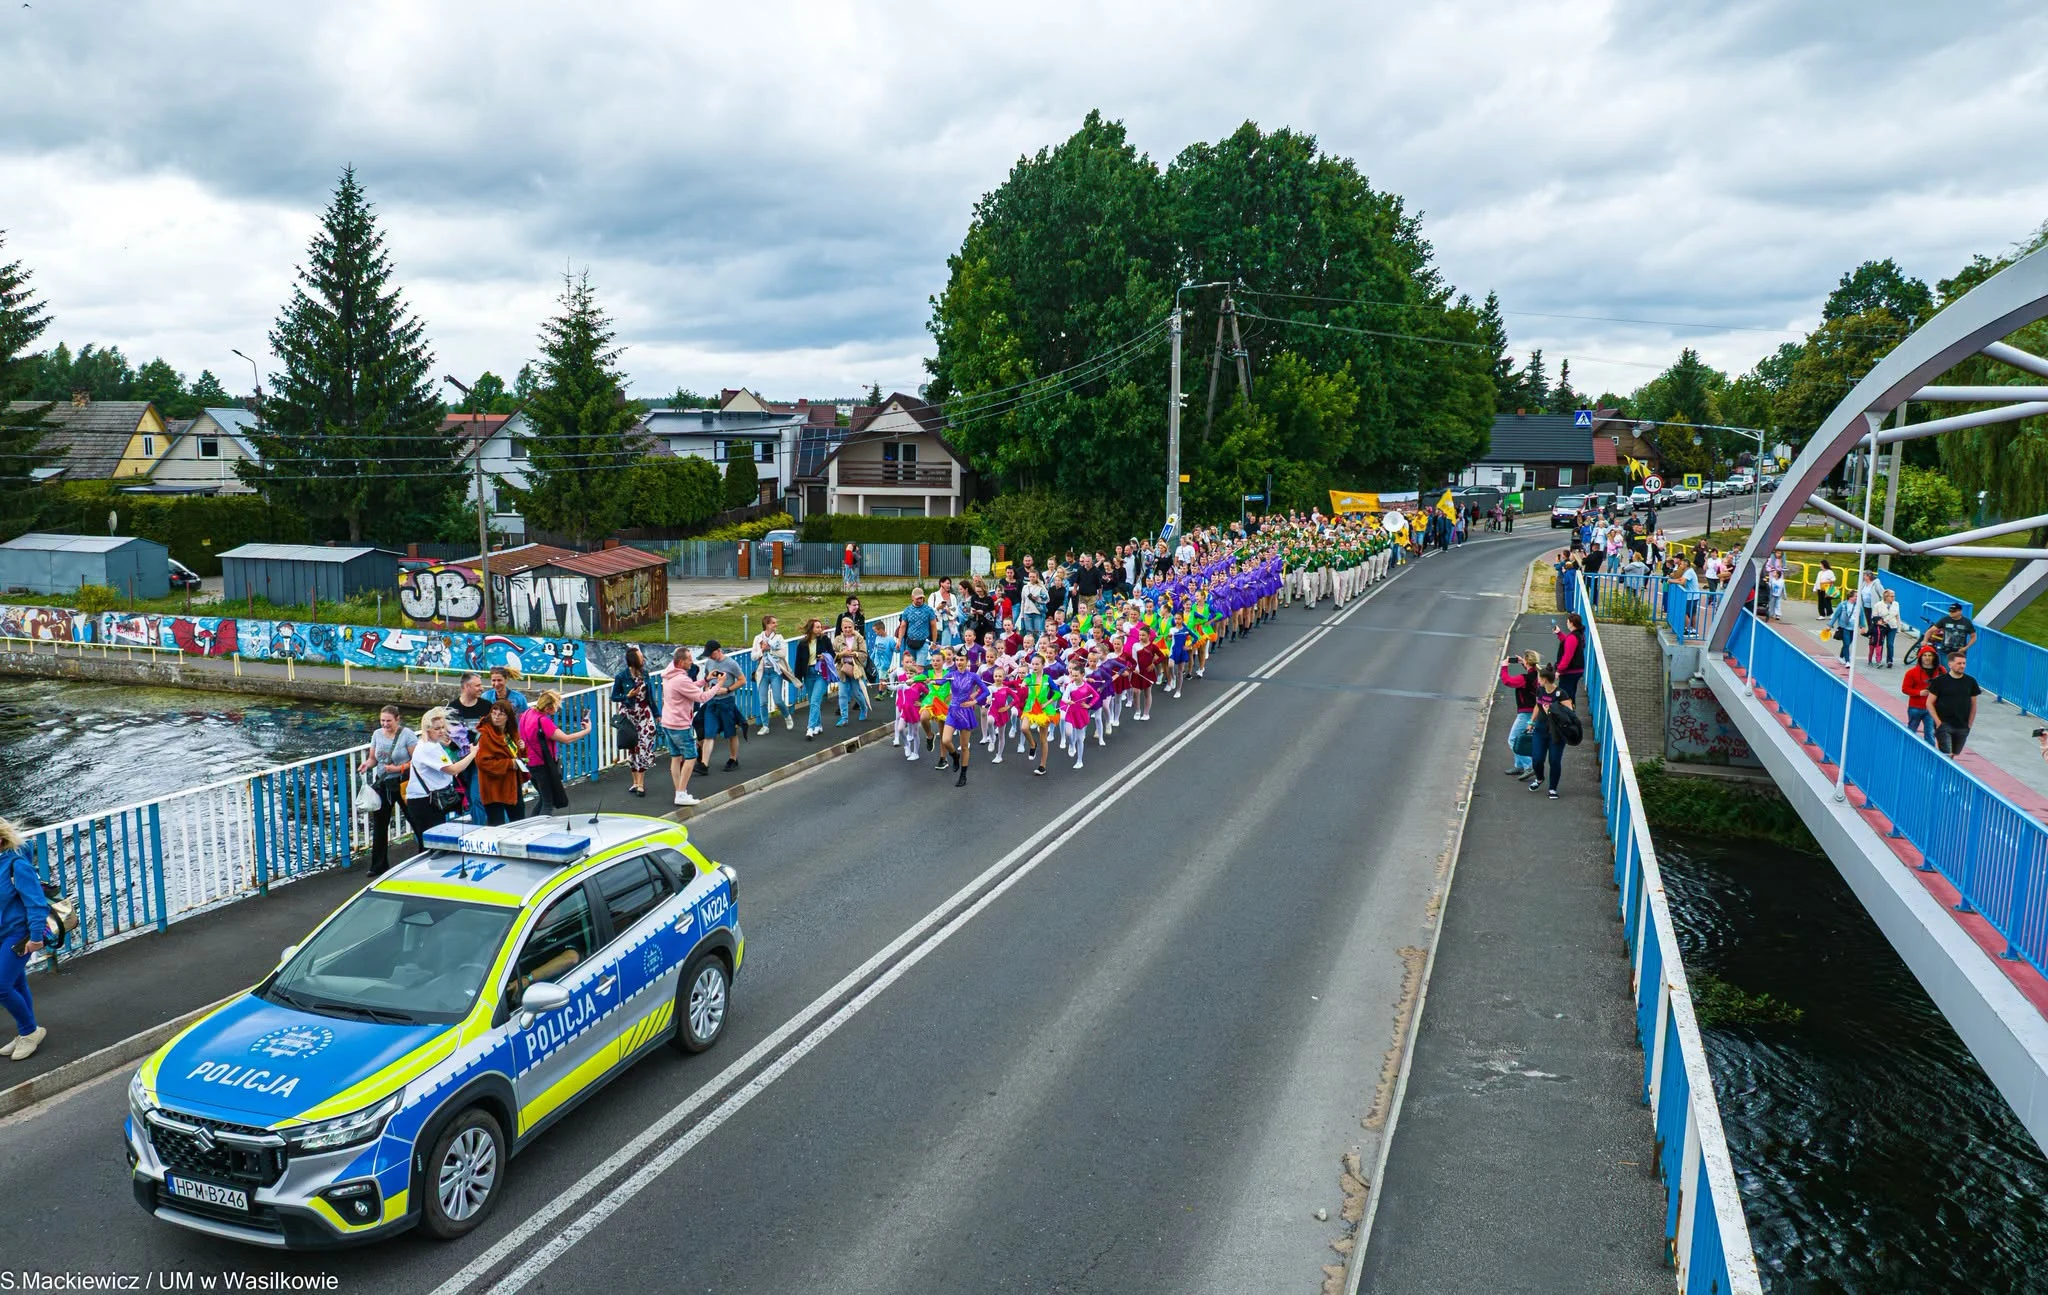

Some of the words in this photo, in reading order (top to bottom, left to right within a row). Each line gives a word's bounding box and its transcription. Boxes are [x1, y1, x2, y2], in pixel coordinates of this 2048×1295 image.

[1646, 480, 1660, 489] 40
[400, 569, 485, 622] JB
[458, 838, 498, 855] POLICJA
[701, 892, 729, 926] M224
[525, 992, 597, 1060] POLICJA
[185, 1061, 301, 1098] POLICJA
[175, 1178, 205, 1199] HPM
[208, 1185, 246, 1209] B246
